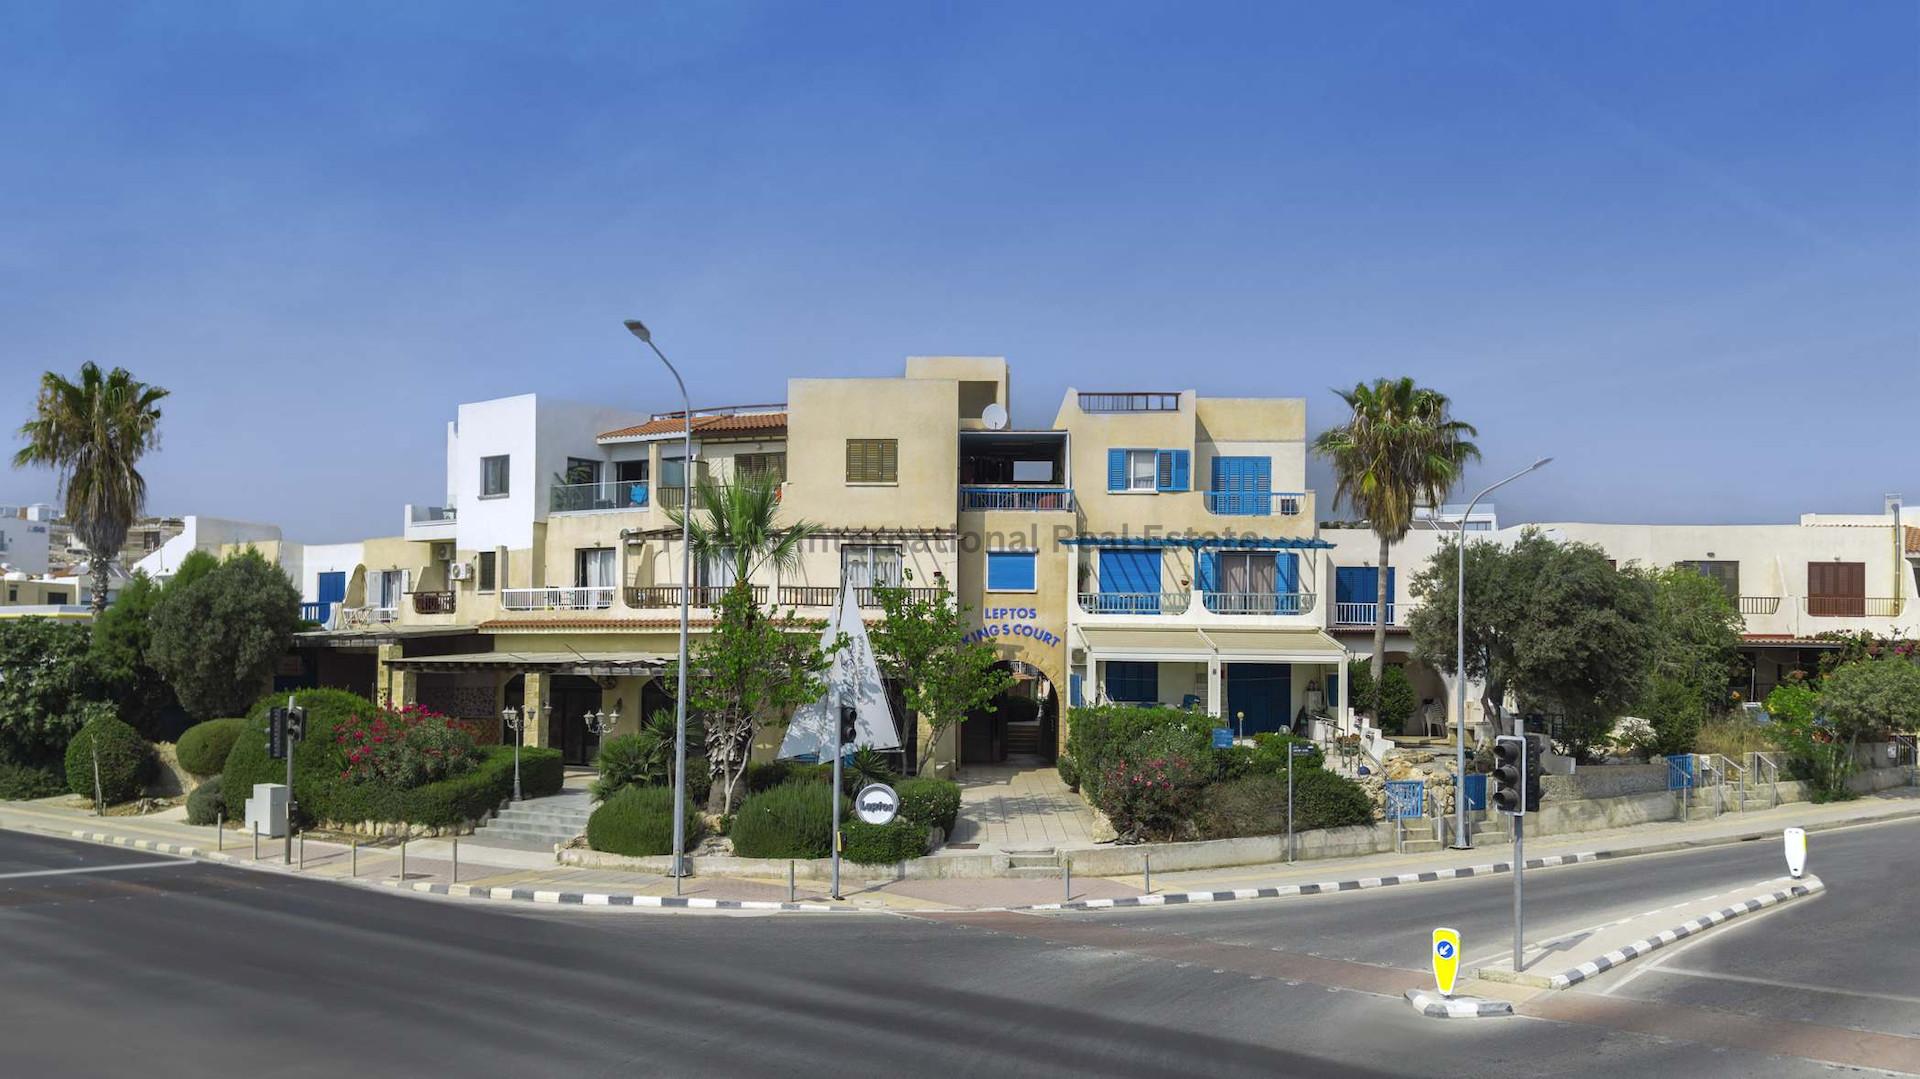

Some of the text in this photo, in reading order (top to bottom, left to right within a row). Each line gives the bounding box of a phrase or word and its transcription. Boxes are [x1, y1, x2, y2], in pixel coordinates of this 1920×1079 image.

[984, 608, 1037, 619] LEPTOS
[1013, 623, 1061, 648] COURT
[860, 800, 893, 813] Leptos
